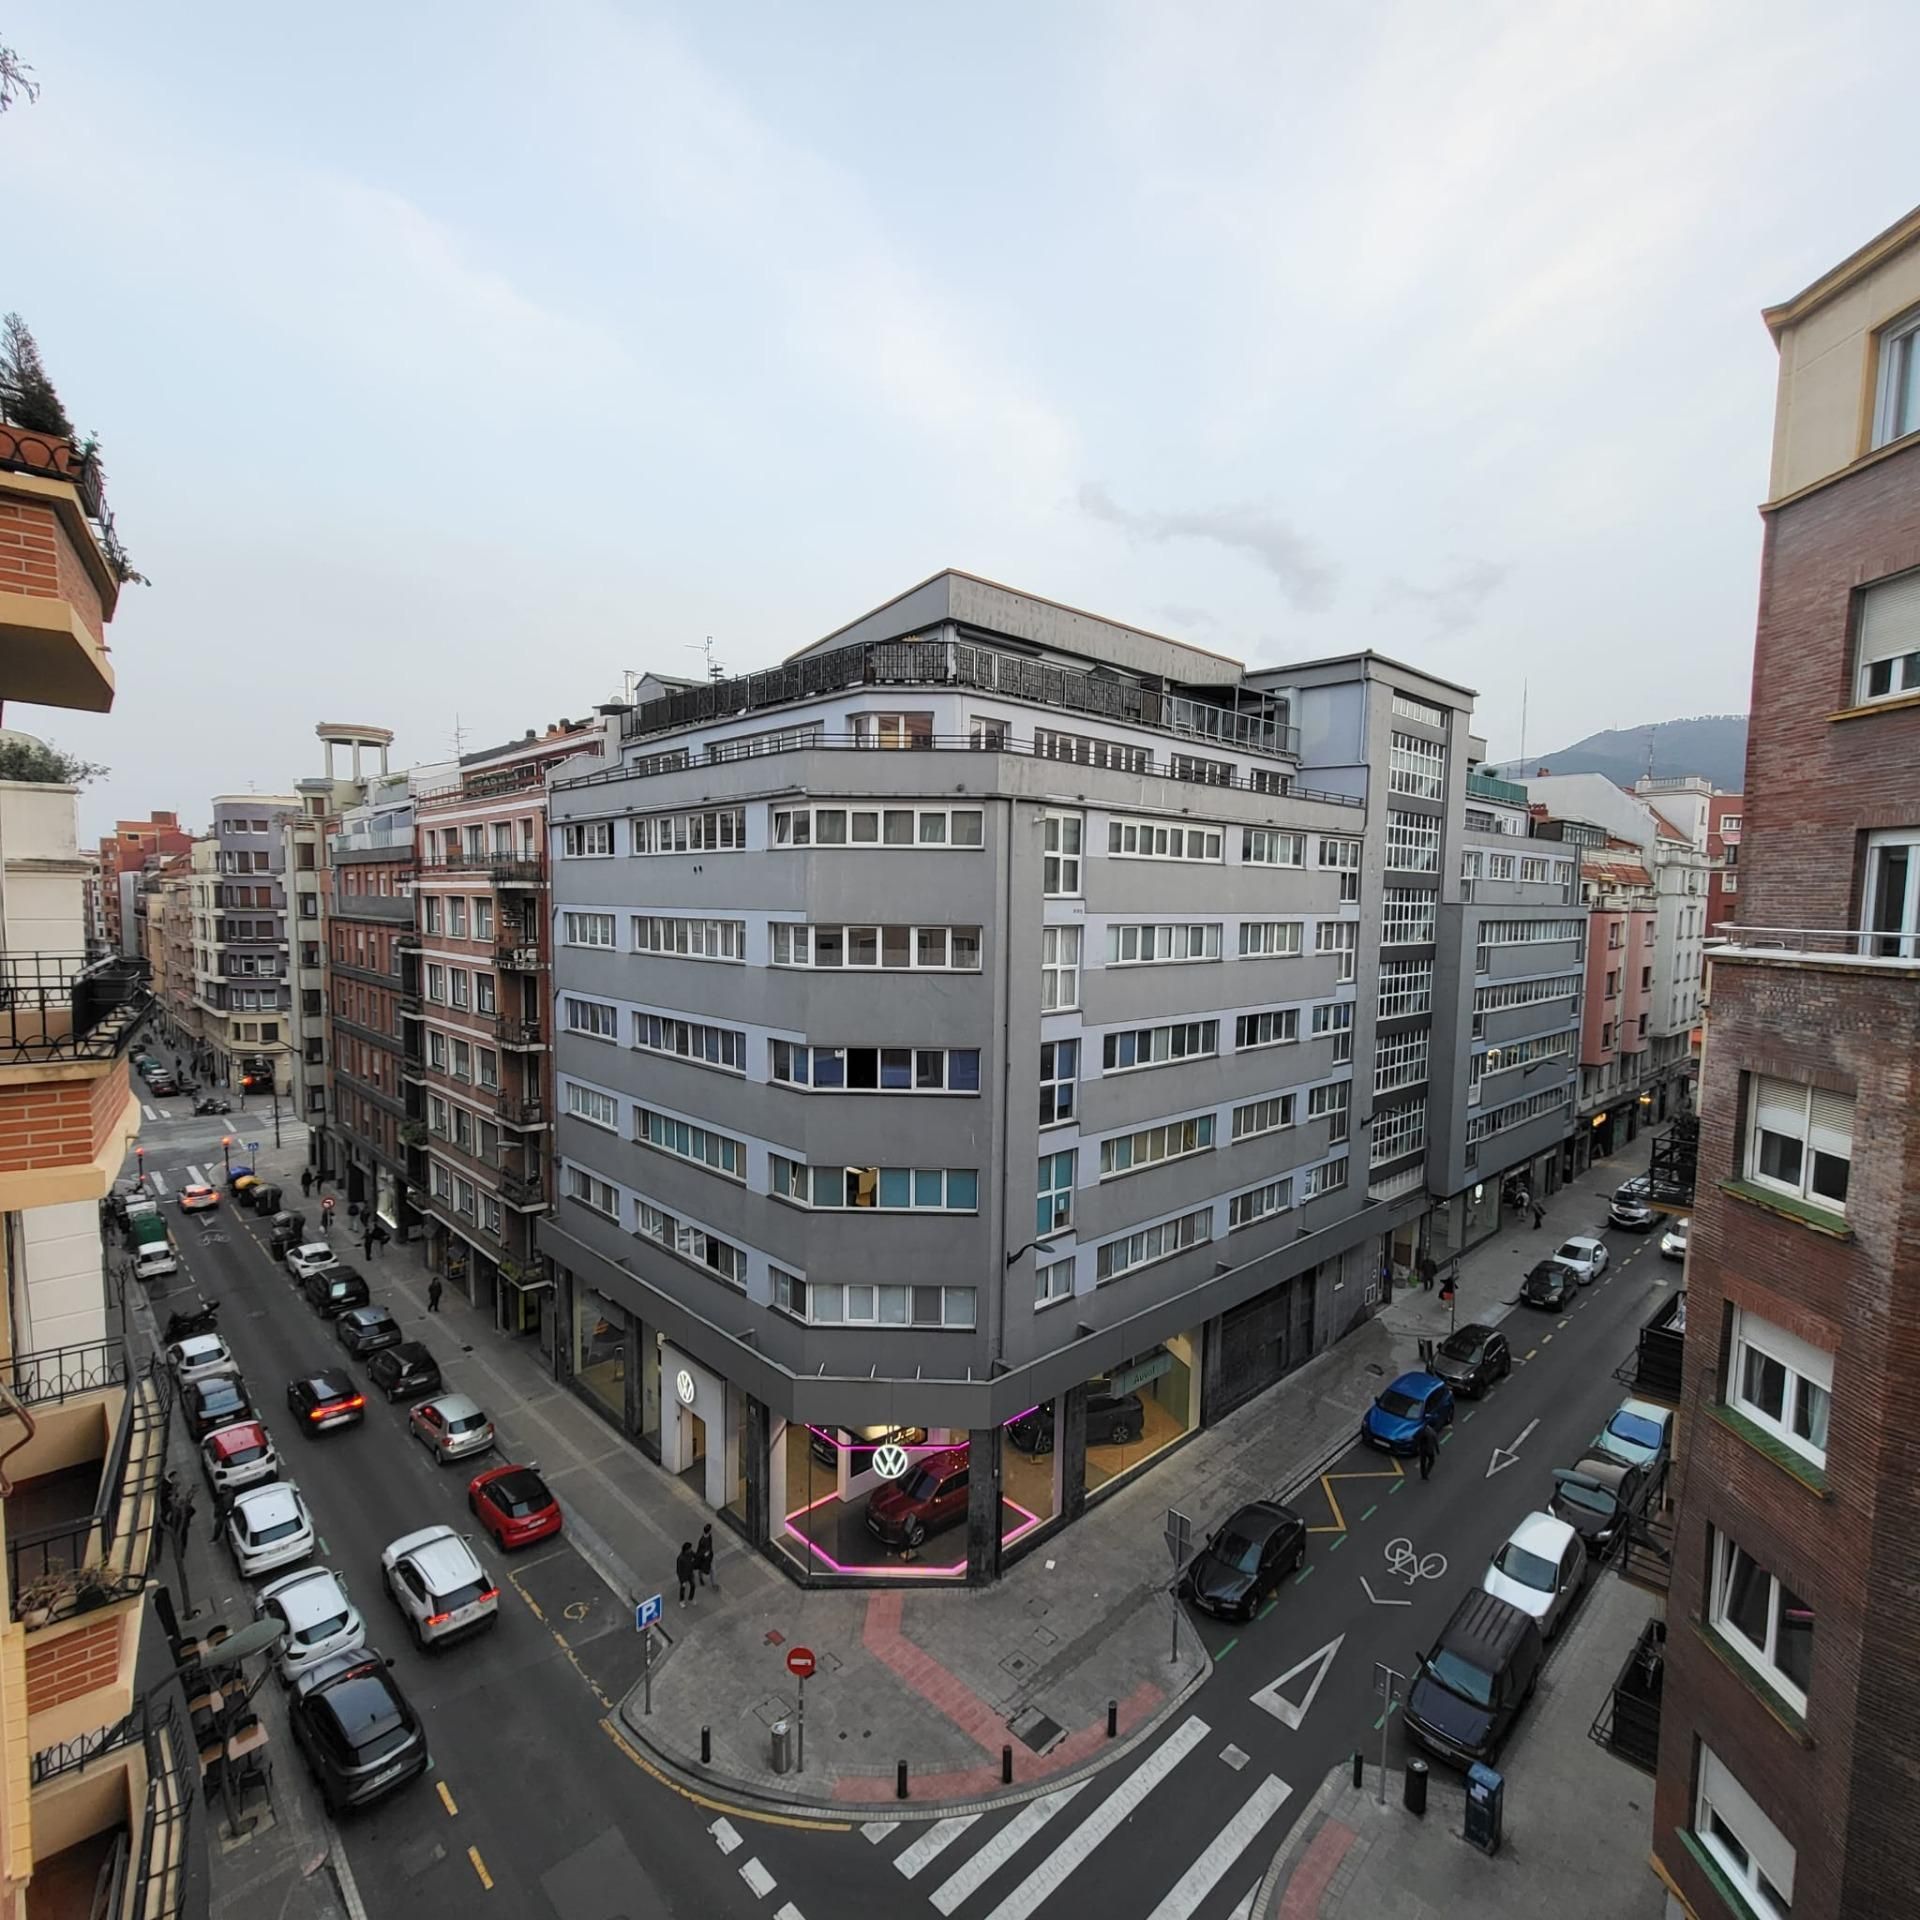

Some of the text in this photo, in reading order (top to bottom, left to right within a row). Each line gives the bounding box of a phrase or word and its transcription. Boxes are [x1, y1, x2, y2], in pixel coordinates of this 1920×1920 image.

[677, 1371, 694, 1403] VW
[874, 1445, 906, 1477] VW
[641, 1600, 657, 1625] P
